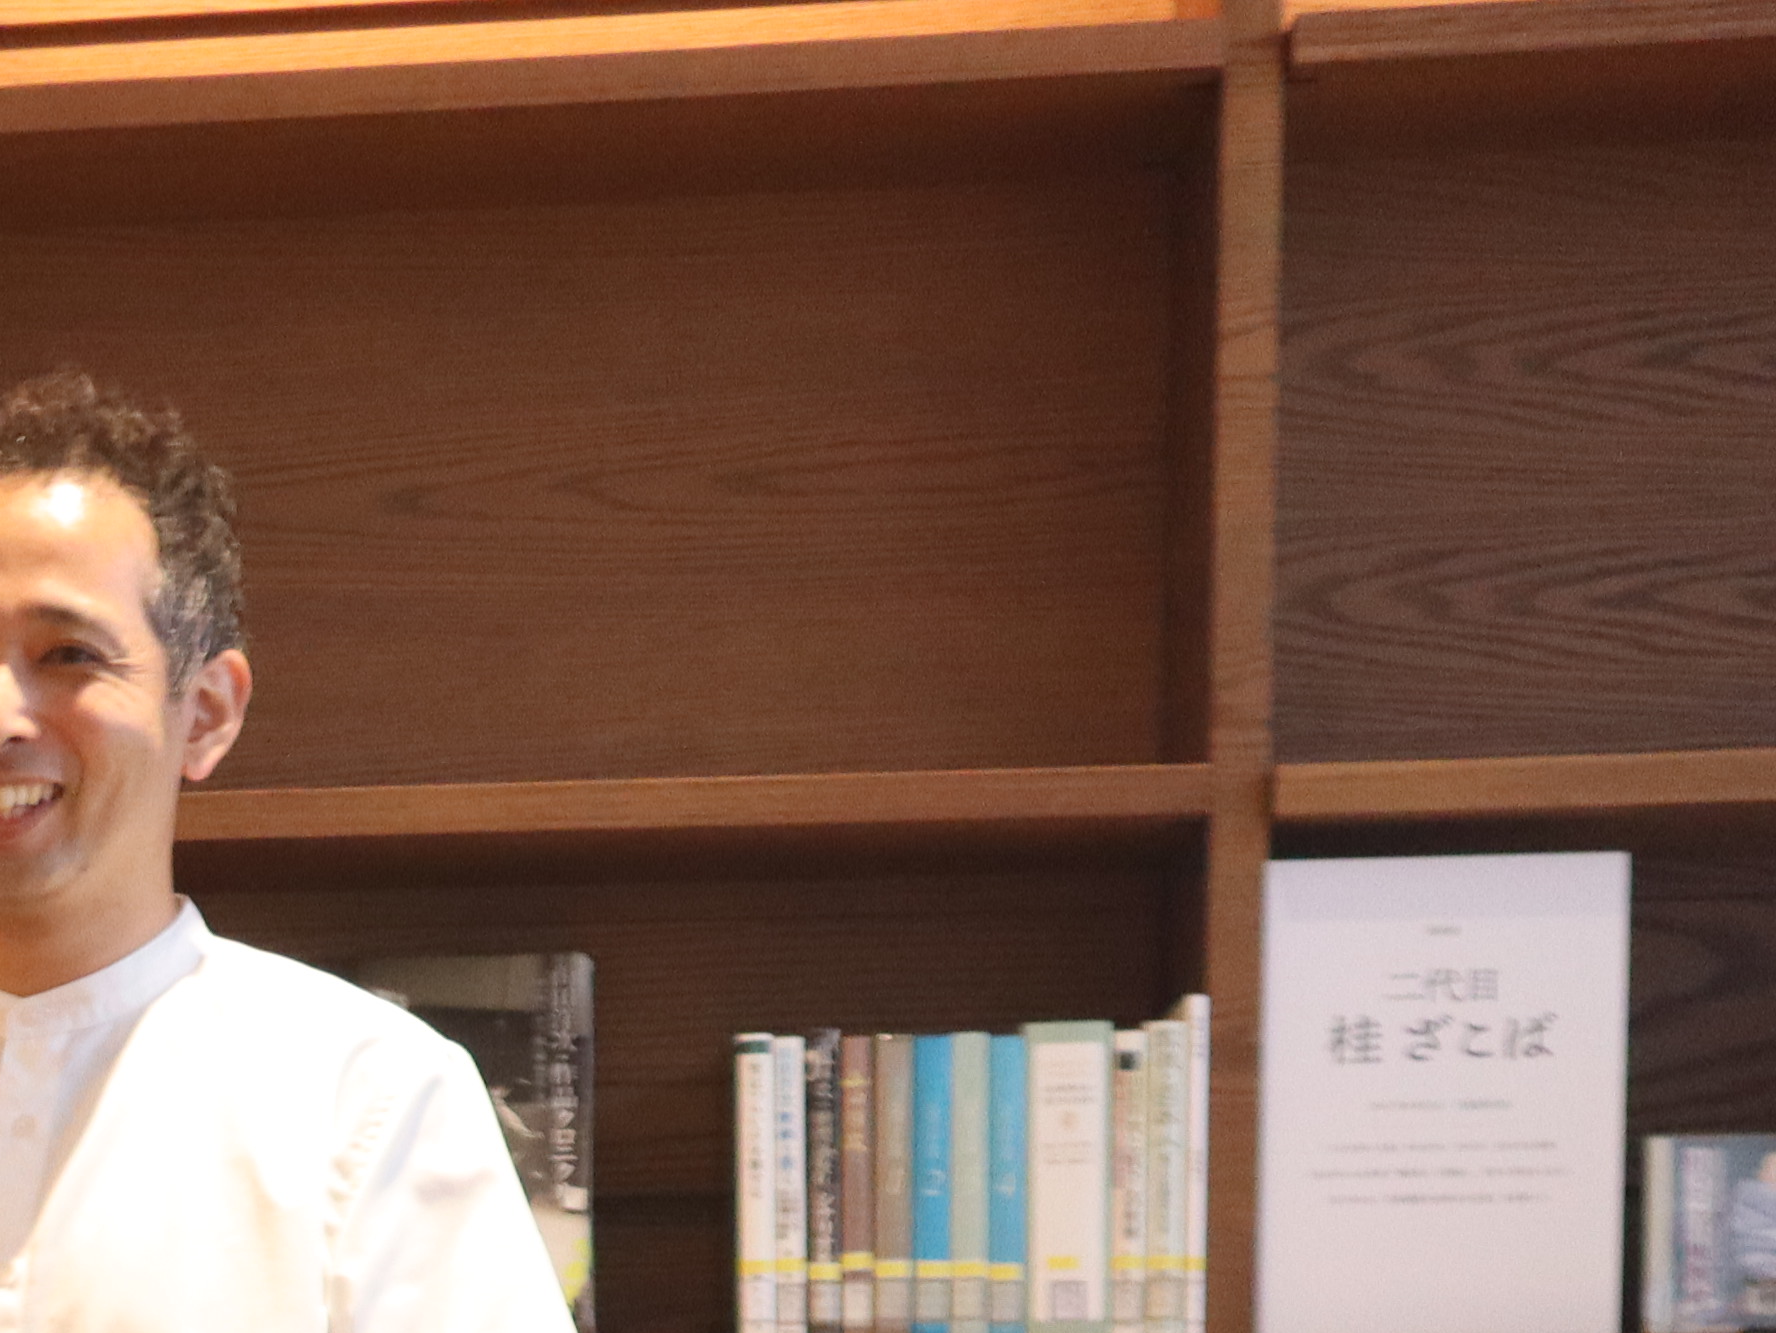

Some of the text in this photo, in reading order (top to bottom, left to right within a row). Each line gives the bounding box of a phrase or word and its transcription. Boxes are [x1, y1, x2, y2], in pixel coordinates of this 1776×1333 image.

[1383, 967, 1500, 1003] 二代目
[1402, 1010, 1560, 1061] ざこば
